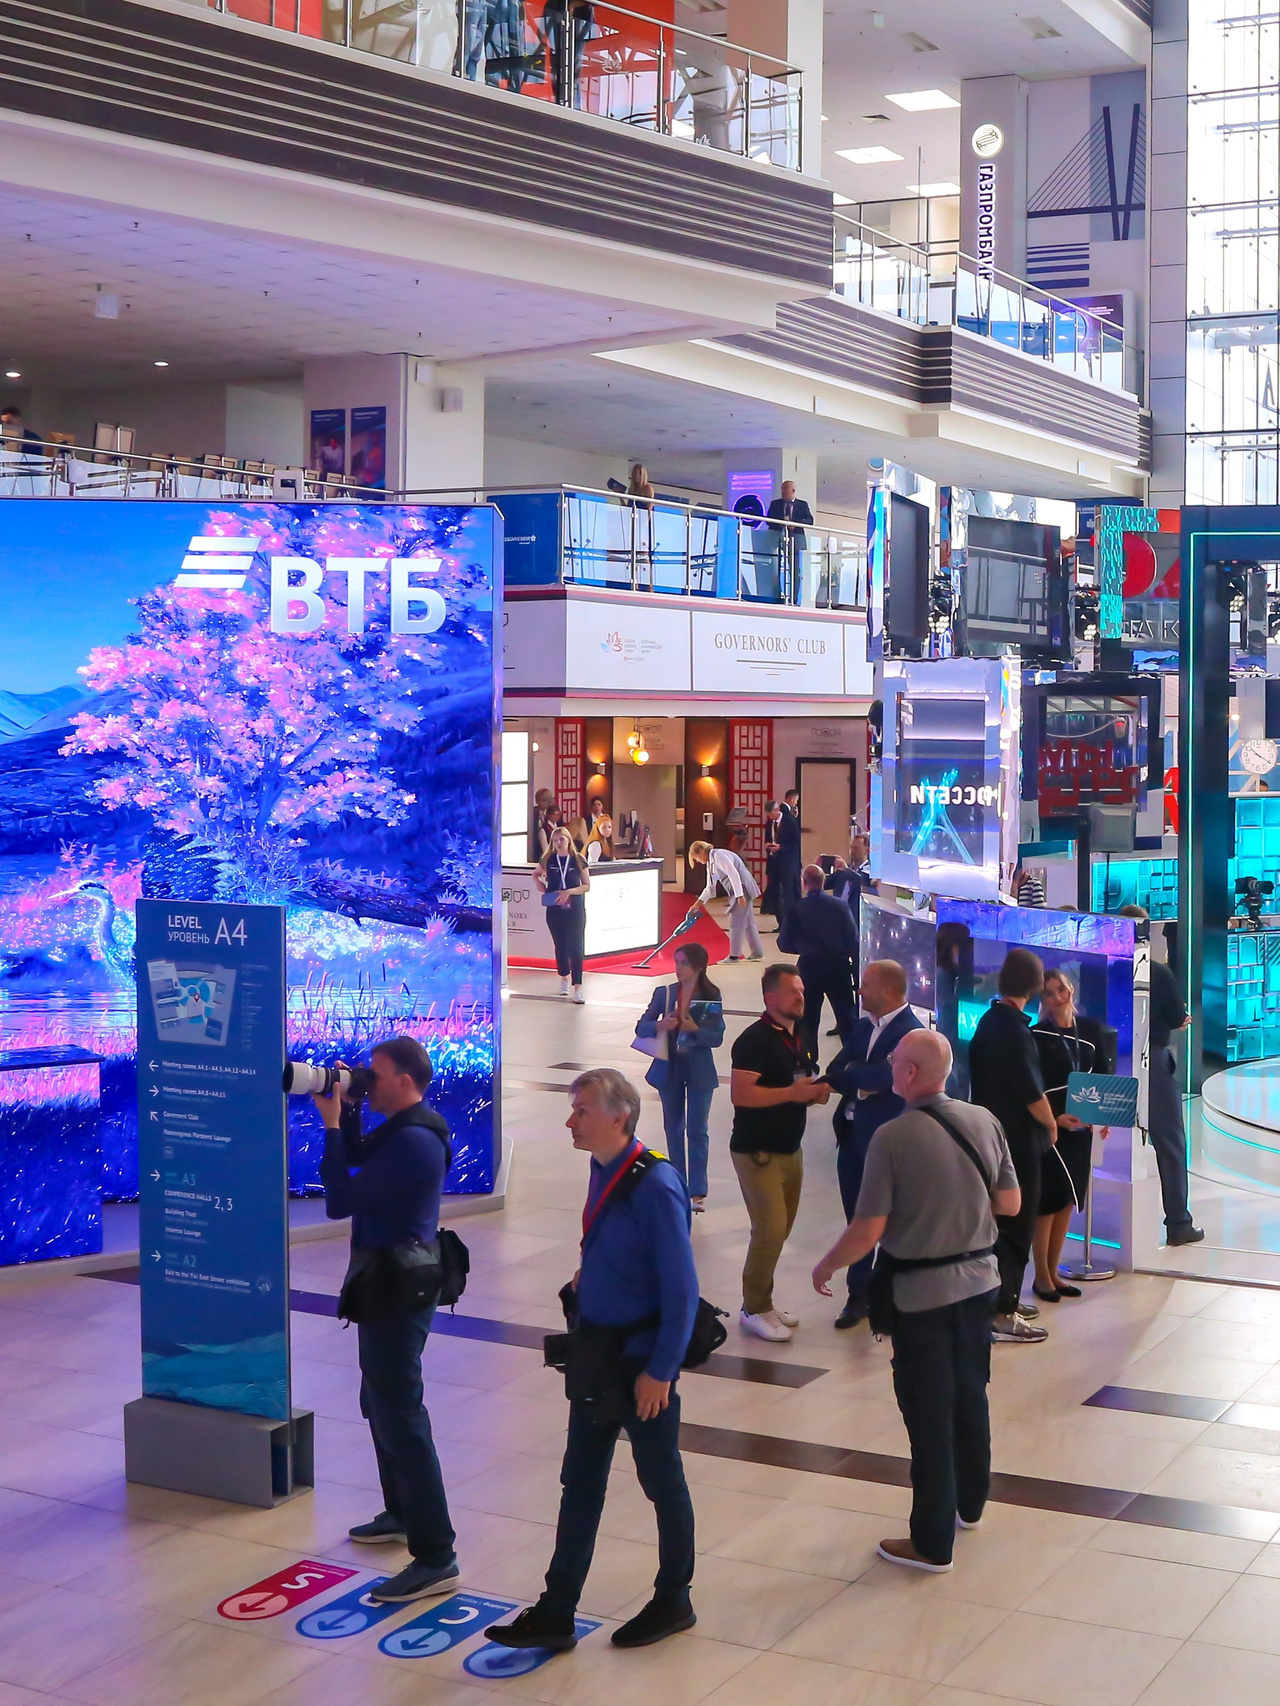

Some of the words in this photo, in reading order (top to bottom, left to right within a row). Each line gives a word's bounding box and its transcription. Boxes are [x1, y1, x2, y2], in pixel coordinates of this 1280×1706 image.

[271, 556, 446, 634] ВТБ
[797, 638, 827, 655] CLUB
[168, 915, 202, 929] LEVEL
[214, 917, 248, 946] A4
[168, 931, 210, 944] УРОВЕНЬ
[182, 1173, 196, 1186] A3
[196, 1193, 212, 1202] HALLS
[226, 1197, 233, 1210] 3
[183, 1254, 196, 1267] A2
[281, 1572, 325, 1590] S
